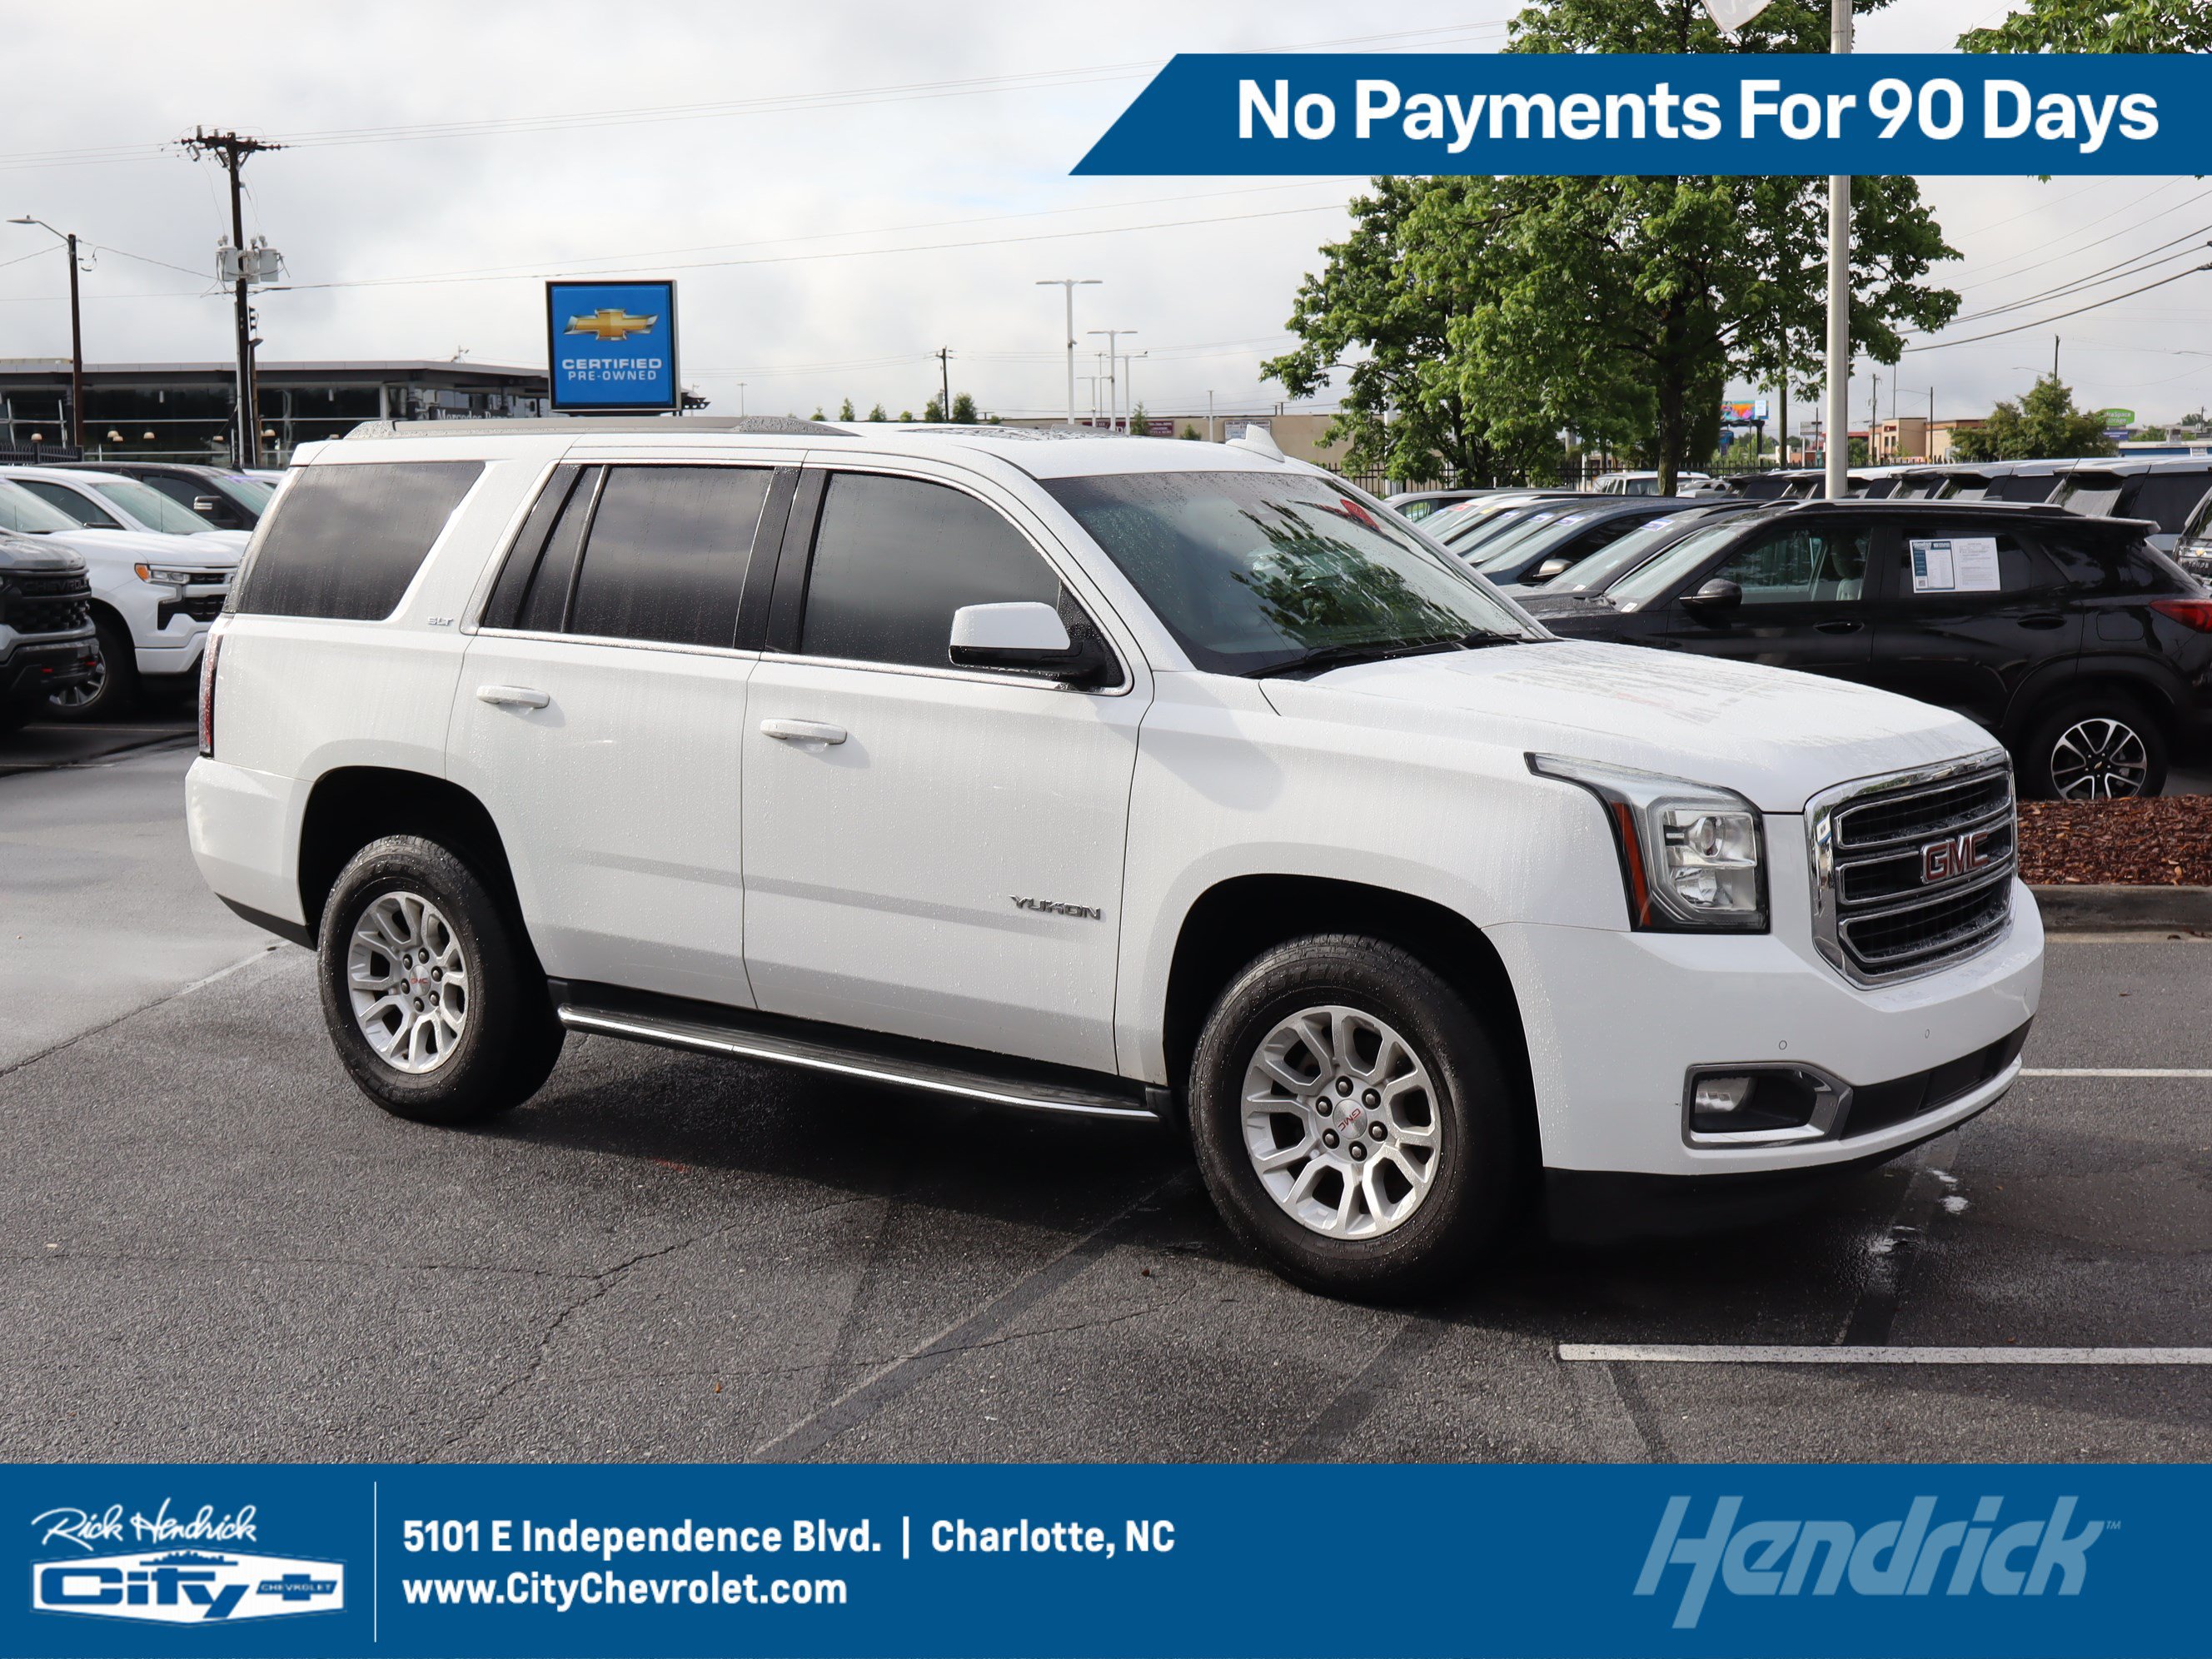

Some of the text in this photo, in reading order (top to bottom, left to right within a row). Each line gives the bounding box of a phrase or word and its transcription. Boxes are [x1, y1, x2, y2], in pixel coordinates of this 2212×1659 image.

[561, 358, 662, 370] CERTIFIED
[568, 371, 657, 381] PRE-OWNED
[428, 617, 454, 626] SLT
[1921, 830, 1989, 884] GMC
[1009, 895, 1101, 920] YUKON
[1338, 1108, 1362, 1132] GMC
